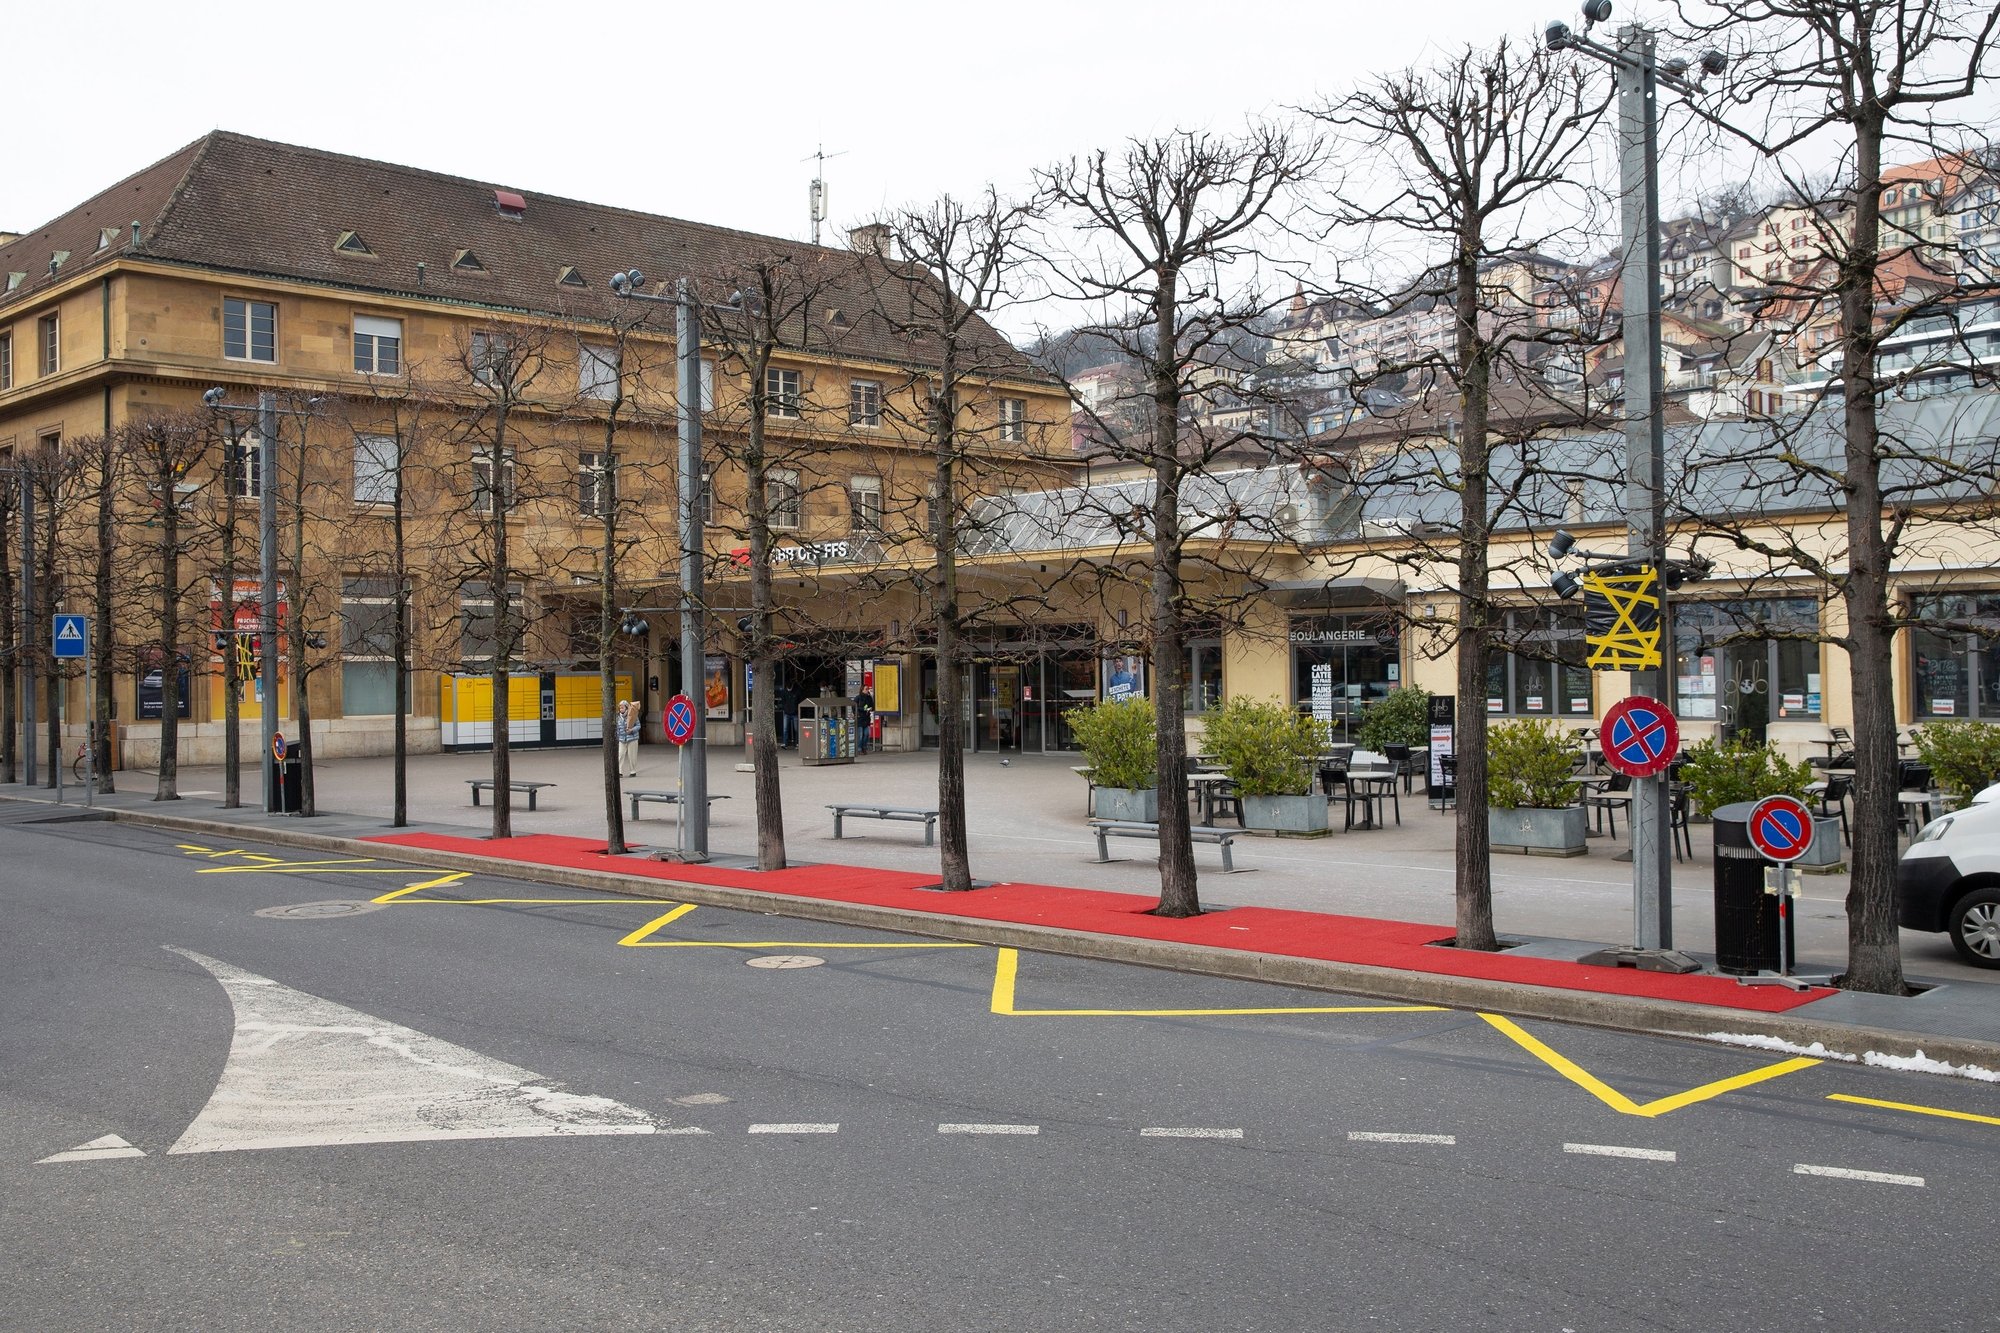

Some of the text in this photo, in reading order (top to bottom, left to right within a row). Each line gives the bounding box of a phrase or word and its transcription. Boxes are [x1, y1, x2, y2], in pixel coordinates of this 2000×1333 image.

[825, 541, 848, 558] FFS
[1290, 630, 1365, 641] BOULANGERIE
[1311, 662, 1332, 671] CAFÉS
[1311, 671, 1332, 679] LATTE
